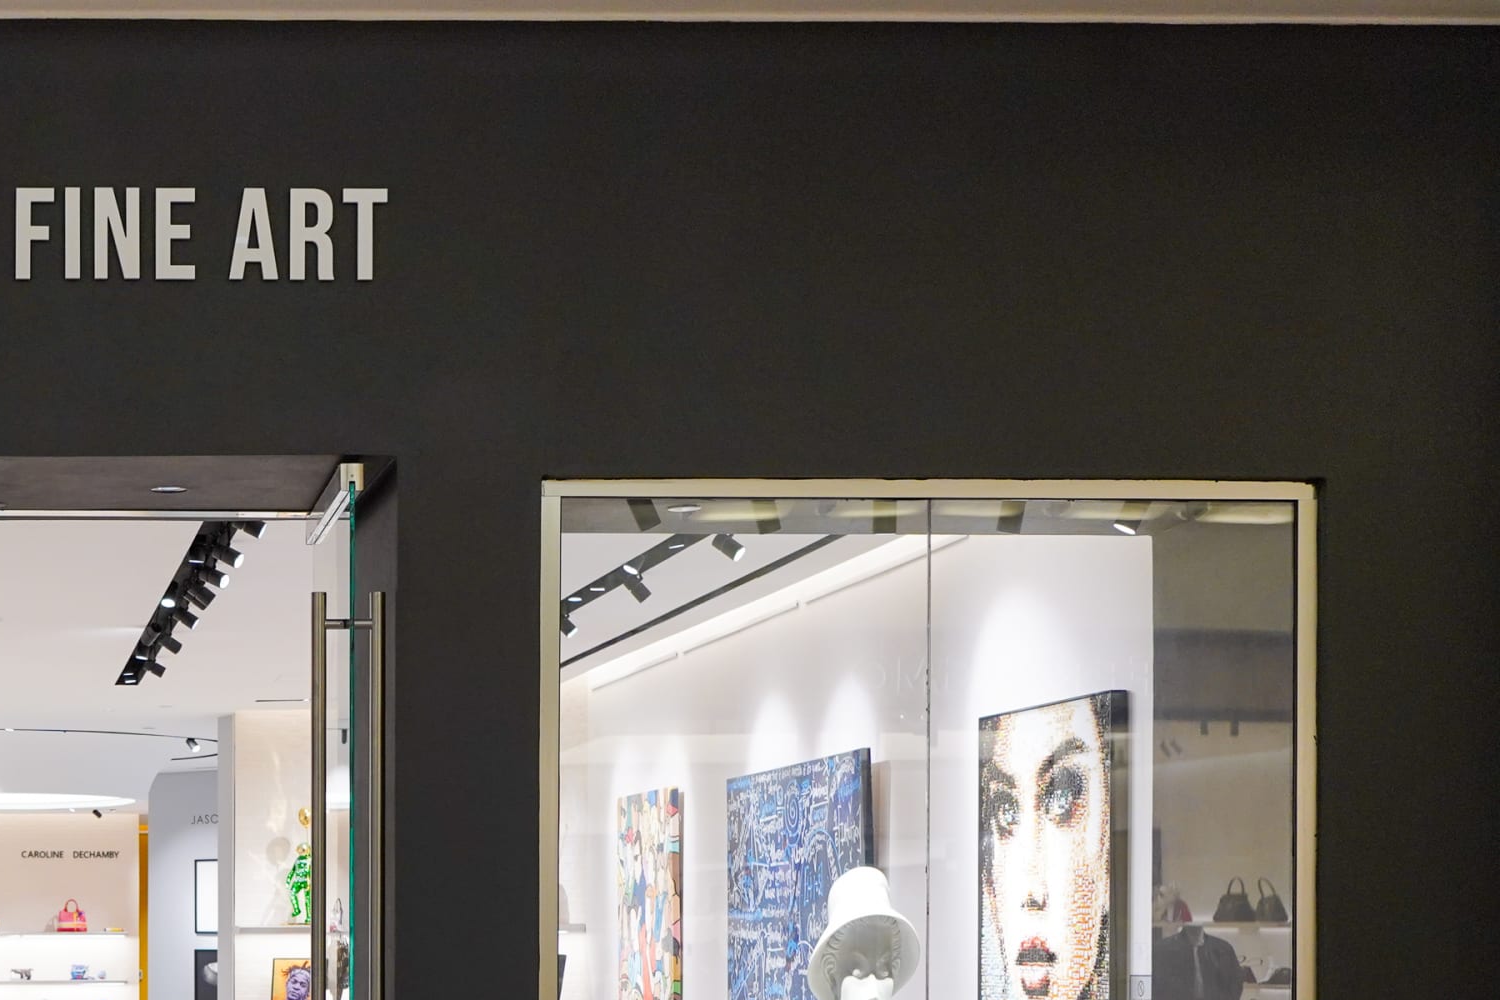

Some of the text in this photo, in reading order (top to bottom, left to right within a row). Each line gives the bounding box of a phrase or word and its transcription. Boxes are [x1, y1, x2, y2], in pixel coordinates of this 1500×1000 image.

[15, 185, 197, 281] FINE
[228, 185, 389, 281] ART
[21, 850, 119, 858] CAROLINE DECHAMBY
